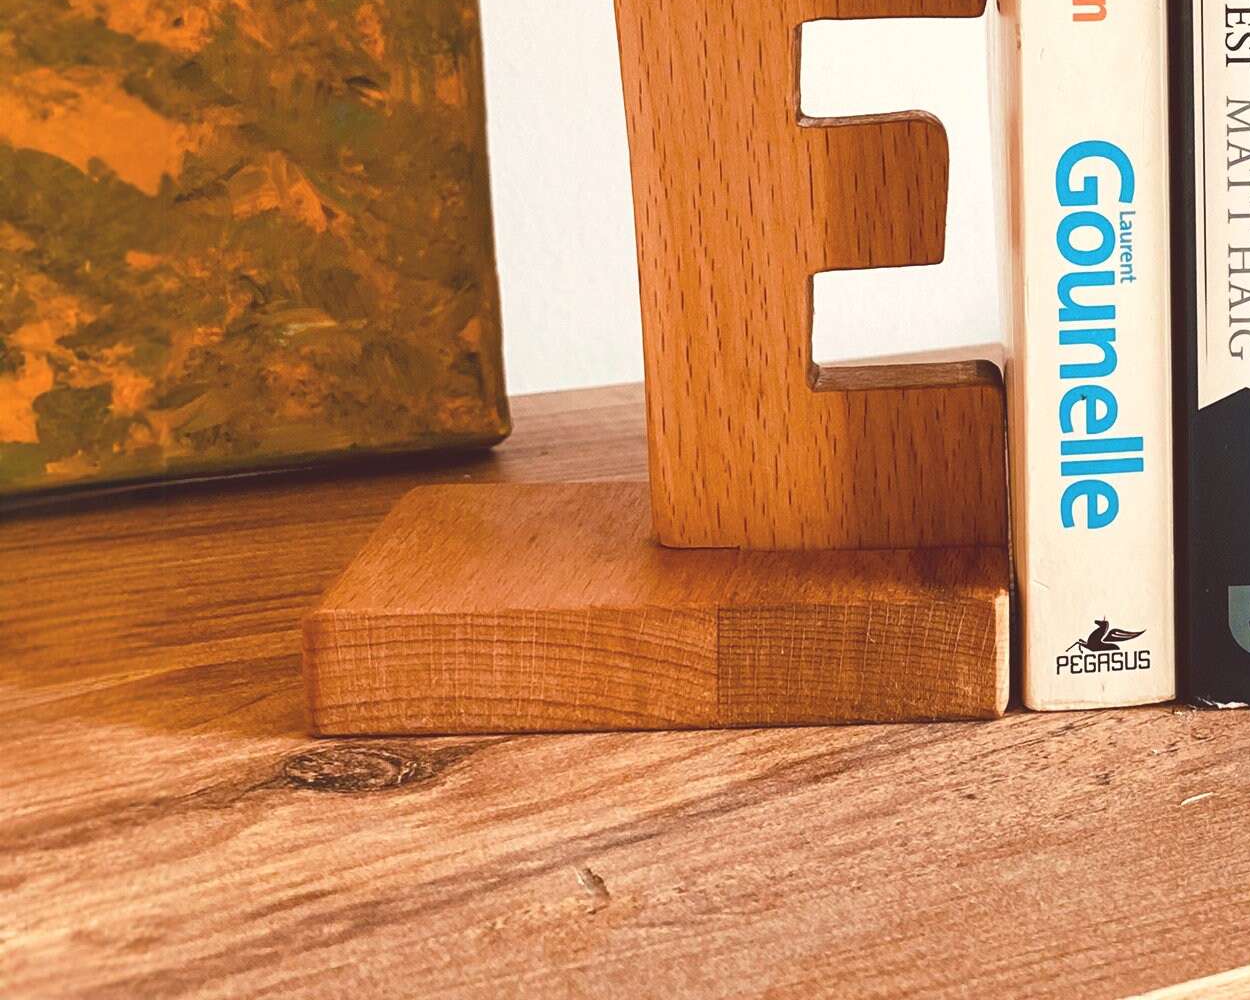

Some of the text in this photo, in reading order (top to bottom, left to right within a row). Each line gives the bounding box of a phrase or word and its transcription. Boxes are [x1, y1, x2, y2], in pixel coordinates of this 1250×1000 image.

[1118, 210, 1137, 284] Laurent
[1055, 139, 1145, 530] Gounelle
[1056, 649, 1151, 676] PEGASUS
